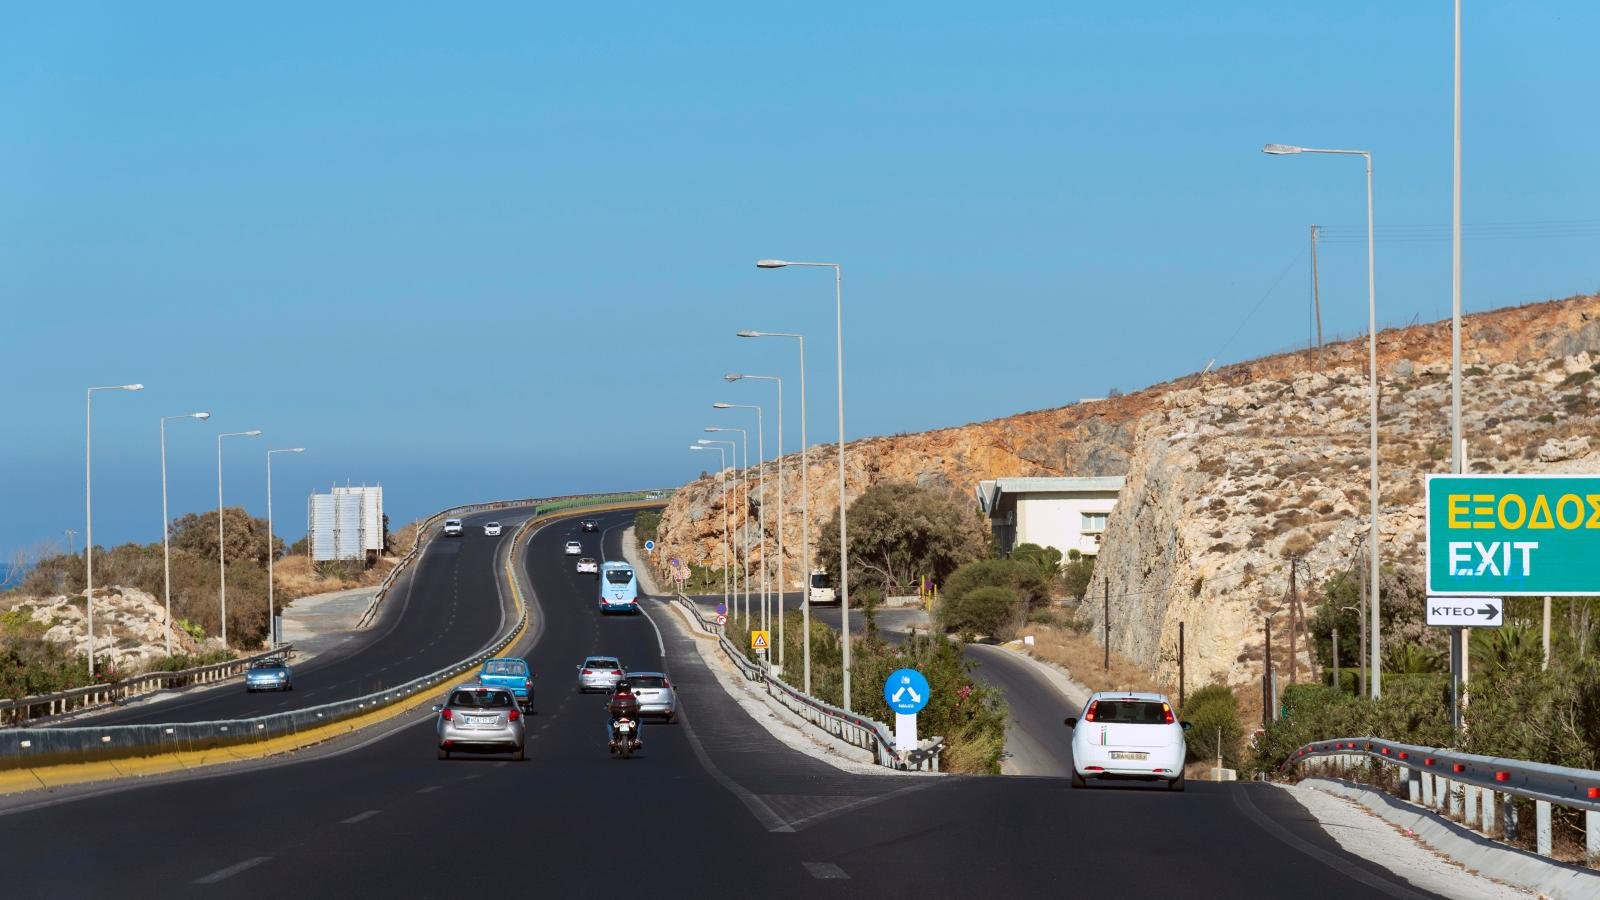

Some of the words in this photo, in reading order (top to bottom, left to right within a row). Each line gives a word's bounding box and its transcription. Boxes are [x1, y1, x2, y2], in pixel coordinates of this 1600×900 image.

[1448, 493, 1600, 529] ΕΞΟΔΟΣ
[1448, 541, 1539, 576] EXIT
[1431, 606, 1475, 617] ΚΤΕΟ
